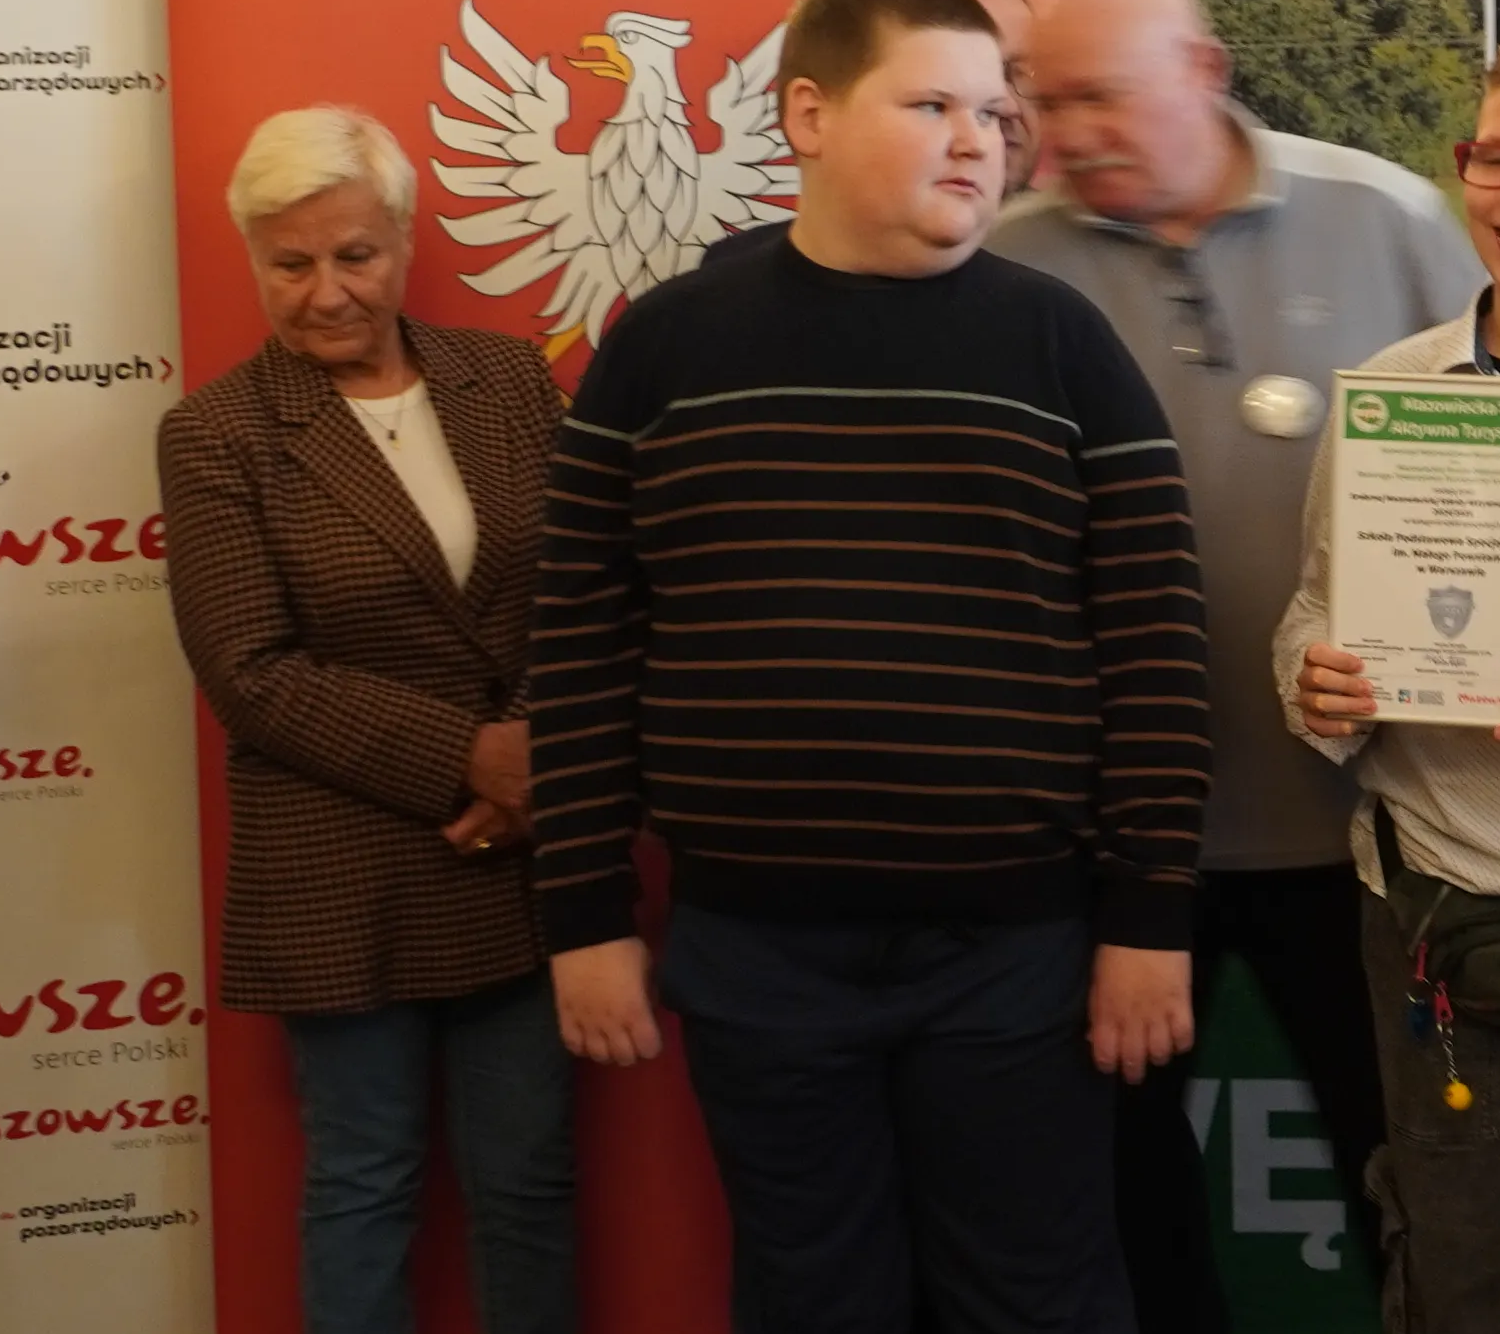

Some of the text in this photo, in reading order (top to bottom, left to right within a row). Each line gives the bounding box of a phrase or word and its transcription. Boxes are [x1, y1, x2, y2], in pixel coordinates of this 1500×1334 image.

[46, 576, 107, 596] serce
[32, 1037, 190, 1070] serce Polski
[18, 1193, 137, 1220] organizacji
[19, 1210, 187, 1243] pozarządowych
